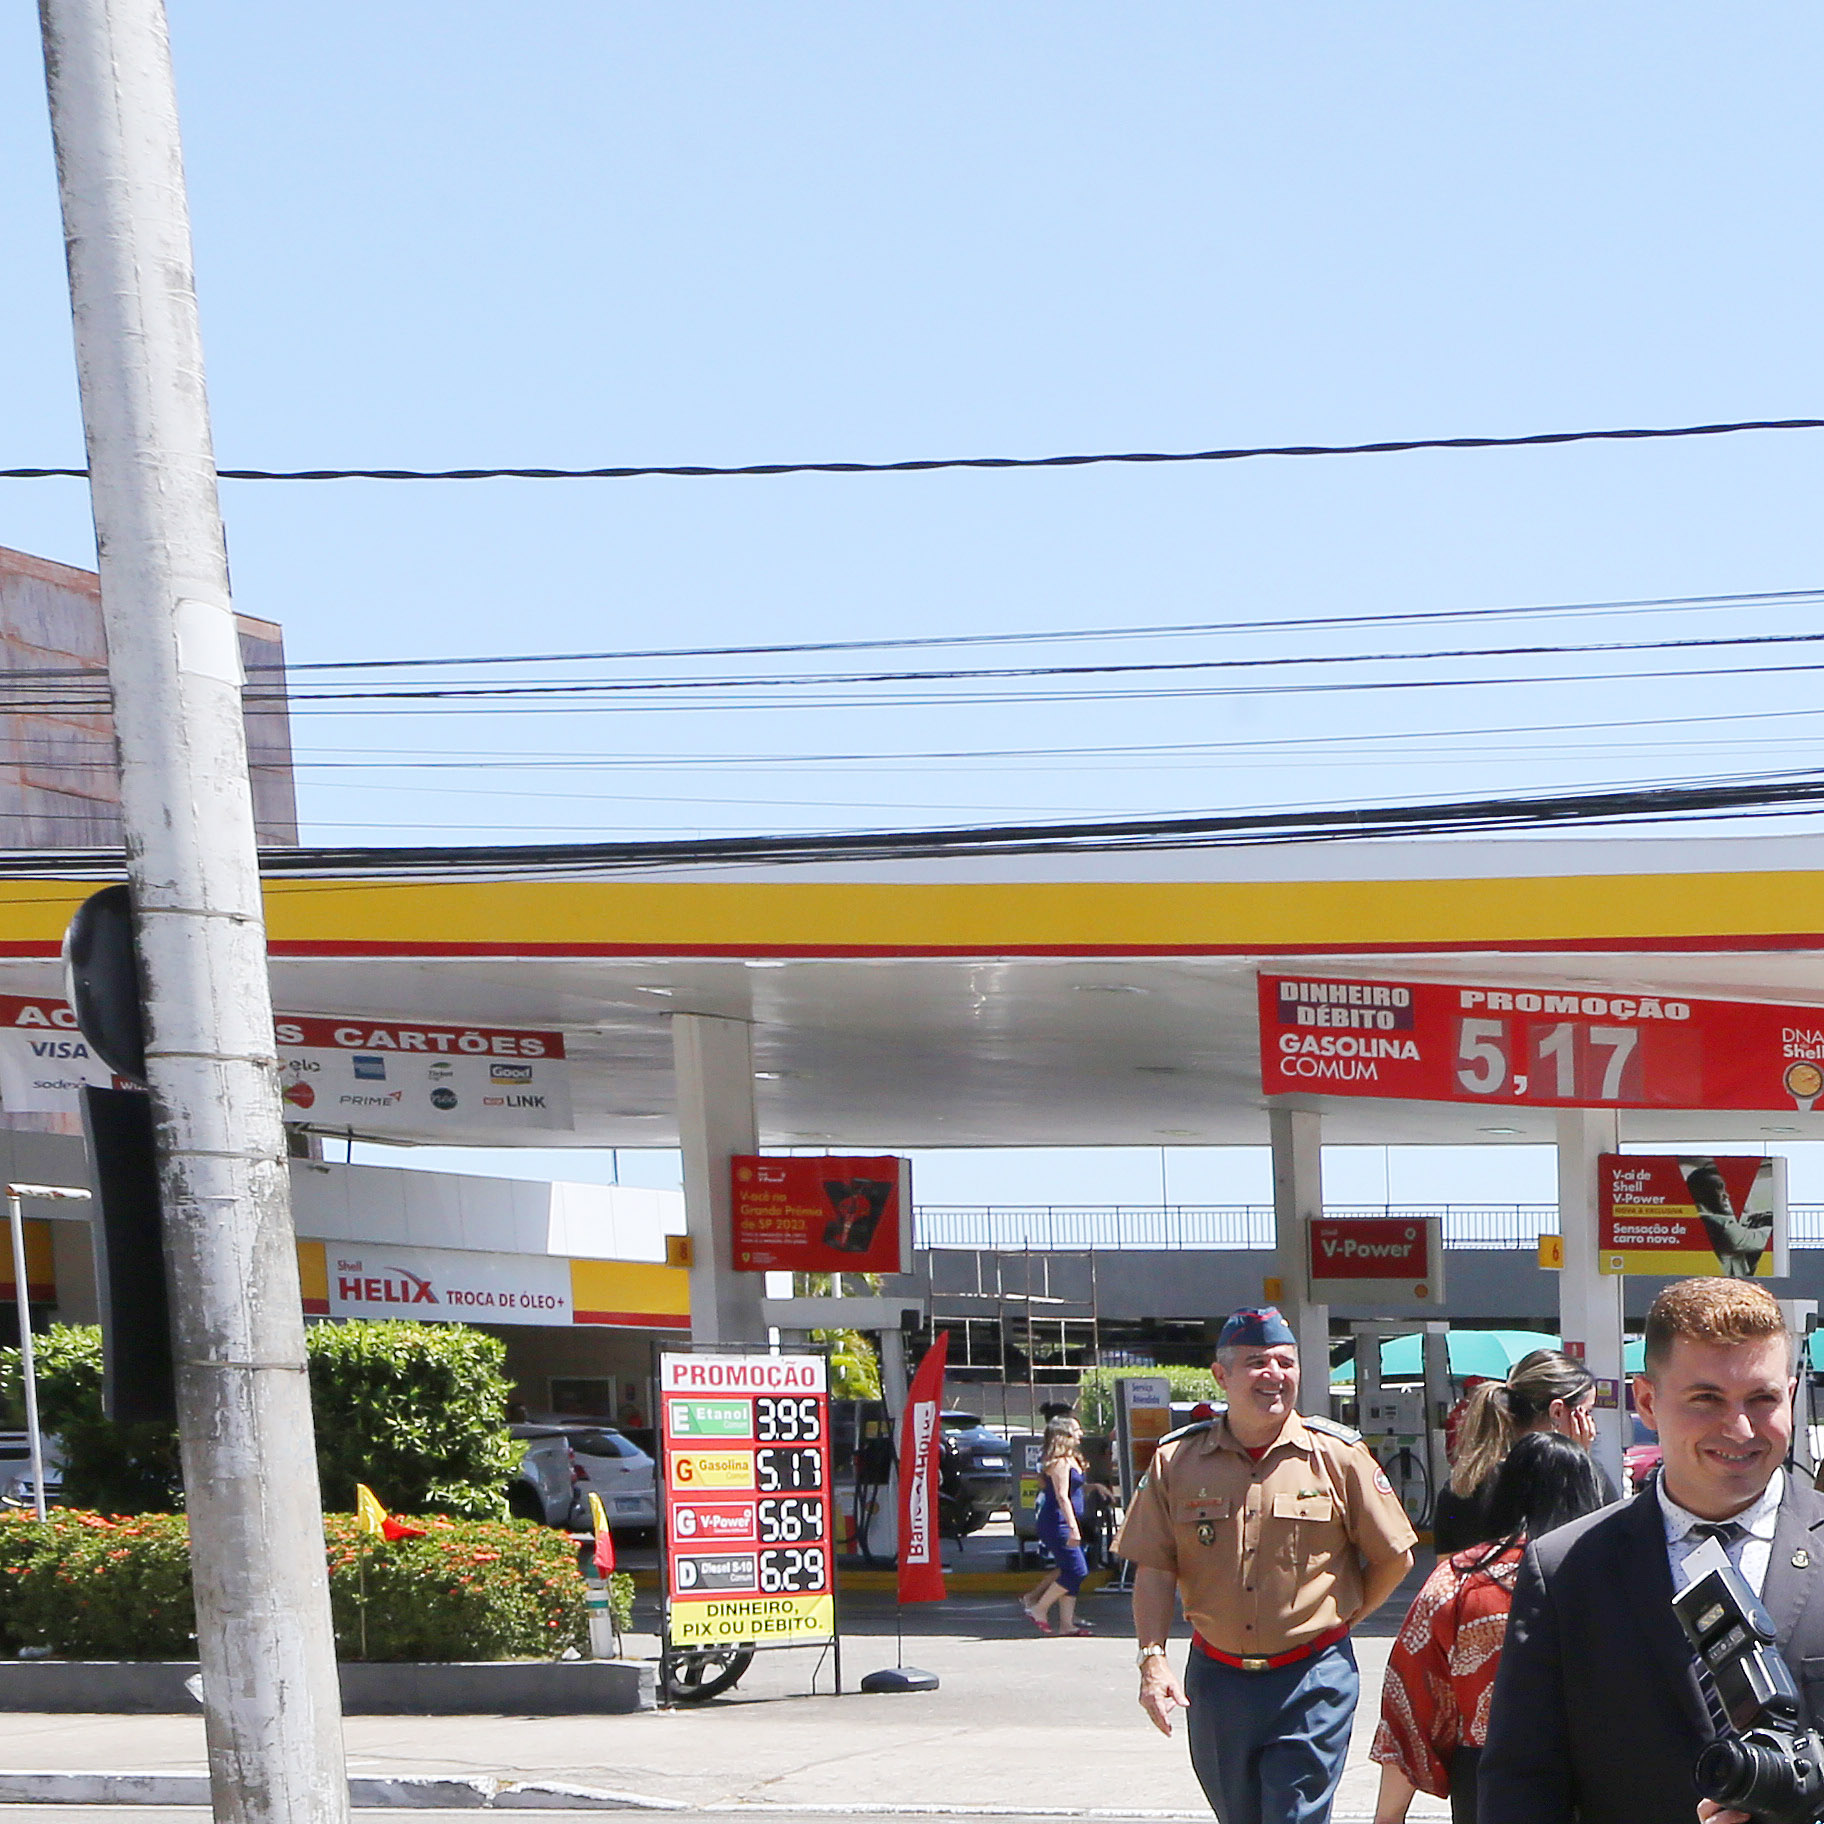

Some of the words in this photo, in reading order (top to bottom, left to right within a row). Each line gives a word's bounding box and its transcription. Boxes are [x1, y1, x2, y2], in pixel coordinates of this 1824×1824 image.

[1279, 981, 1410, 1008] DINHEIRO
[1459, 990, 1691, 1020] PROMOÇÃO
[1297, 1004, 1395, 1030] DÉBITO
[28, 1040, 90, 1060] VISA
[333, 1027, 546, 1056] CARTÕES
[1279, 1033, 1421, 1061] GASOLINA
[1280, 1055, 1378, 1080] COMUM
[1457, 1018, 1638, 1099] 5,17
[491, 1065, 530, 1078] Good
[32, 1076, 87, 1090] sodex
[339, 1095, 392, 1107] PRIME
[506, 1095, 547, 1109] LINK
[1636, 1169, 1651, 1180] de
[1613, 1181, 1643, 1192] Shell
[1613, 1193, 1665, 1204] V-Power
[758, 1219, 773, 1230] SP
[1613, 1223, 1669, 1234] Sensação
[1671, 1223, 1687, 1234] de
[1321, 1239, 1413, 1257] V-Power
[1613, 1235, 1645, 1243] carro
[1646, 1235, 1680, 1244] novo.
[1552, 1243, 1560, 1262] 6
[337, 1260, 363, 1271] Shell
[338, 1276, 440, 1304] HELIX
[446, 1290, 495, 1307] TROCA
[499, 1293, 516, 1307] DE
[672, 1360, 816, 1390] PROMOÇÃO
[673, 1406, 690, 1431] E
[696, 1407, 748, 1421] Etanol
[676, 1459, 693, 1482] G
[699, 1459, 749, 1472] Gasolina
[677, 1509, 696, 1535] G
[700, 1513, 750, 1530] V-Power
[679, 1562, 698, 1588] D
[701, 1562, 731, 1575] Diesel
[732, 1561, 753, 1574] S-10
[706, 1601, 799, 1618] DINHEIRO,
[683, 1623, 712, 1637] PIX
[718, 1621, 745, 1636] OU
[751, 1613, 823, 1634] DÉBITO.
